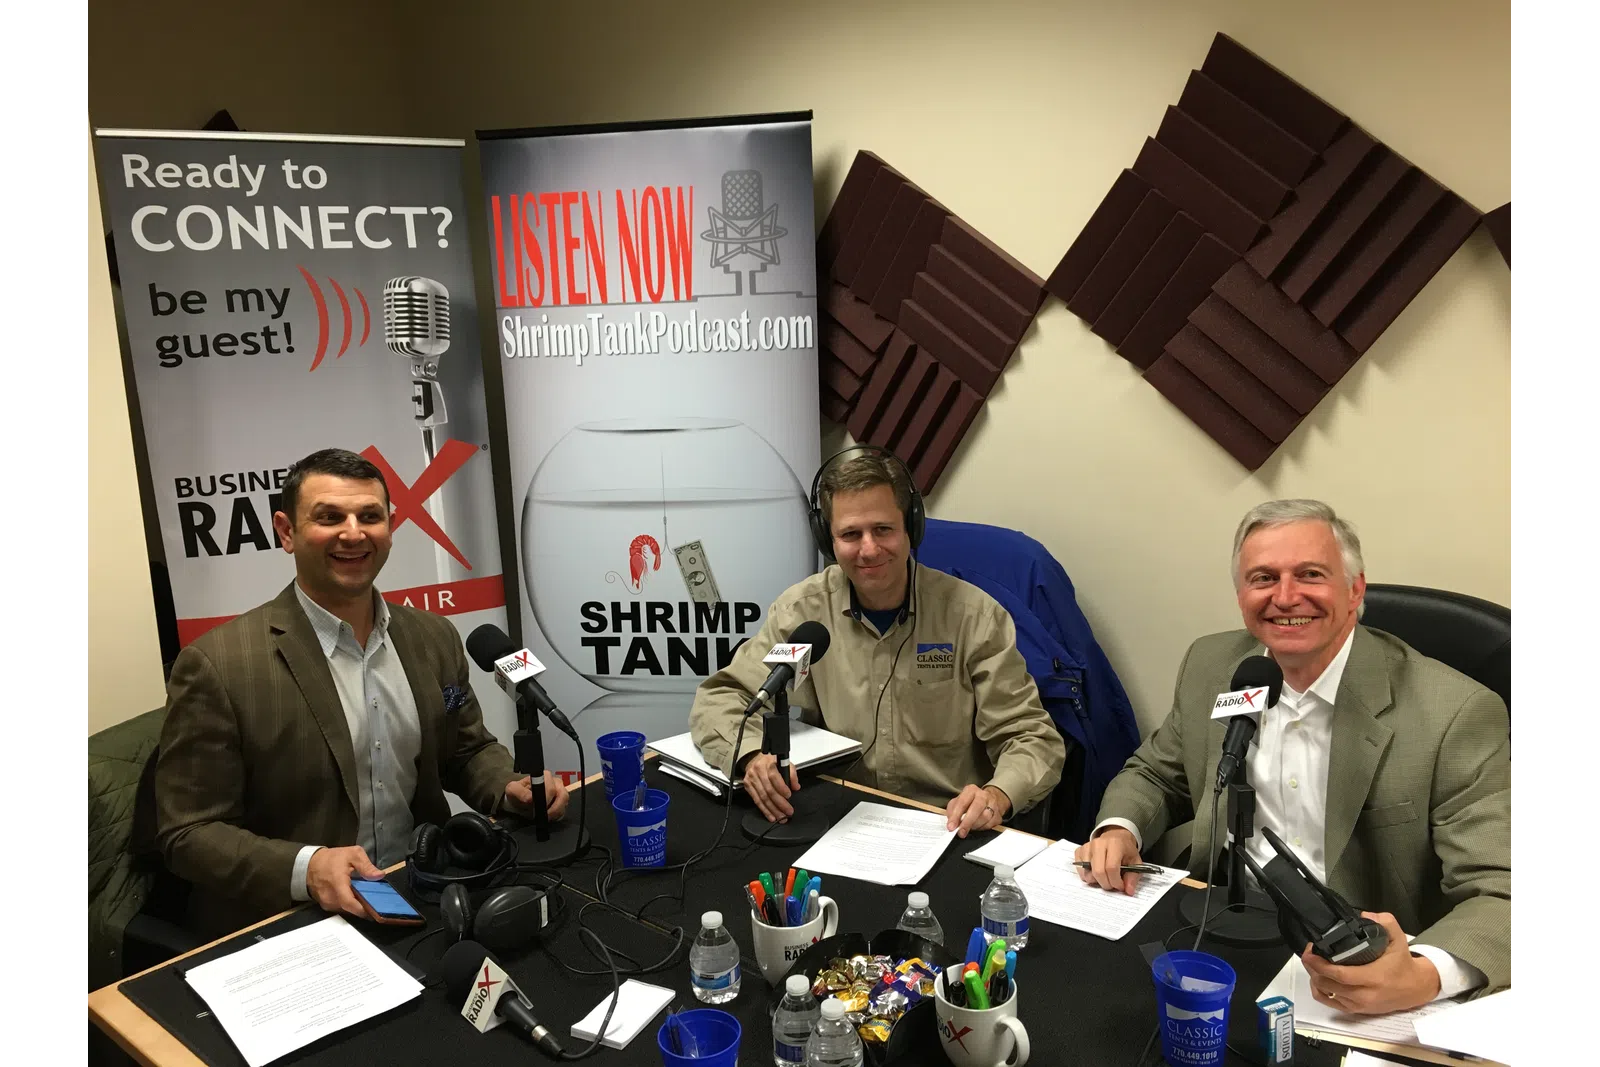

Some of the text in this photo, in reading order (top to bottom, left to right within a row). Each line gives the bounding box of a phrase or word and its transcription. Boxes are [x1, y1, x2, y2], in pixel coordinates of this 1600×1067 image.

[122, 153, 327, 197] Ready to
[131, 204, 453, 253] CONNECT?
[491, 185, 694, 309] LISTEN NOW
[148, 282, 291, 319] be my
[155, 321, 296, 369] guest!
[501, 308, 814, 367] ShrimpTankPodcast.com
[174, 468, 288, 499] BUSINE
[580, 601, 761, 634] SHRIMP
[580, 636, 753, 676] TANK
[916, 654, 954, 663] CLASSIC
[628, 829, 666, 847] CLASSIC
[1166, 1019, 1224, 1040] CLASSIC
[1168, 1031, 1189, 1045] TENTS
[1190, 1039, 1197, 1047] &
[1281, 1020, 1291, 1059] ALTOIDS
